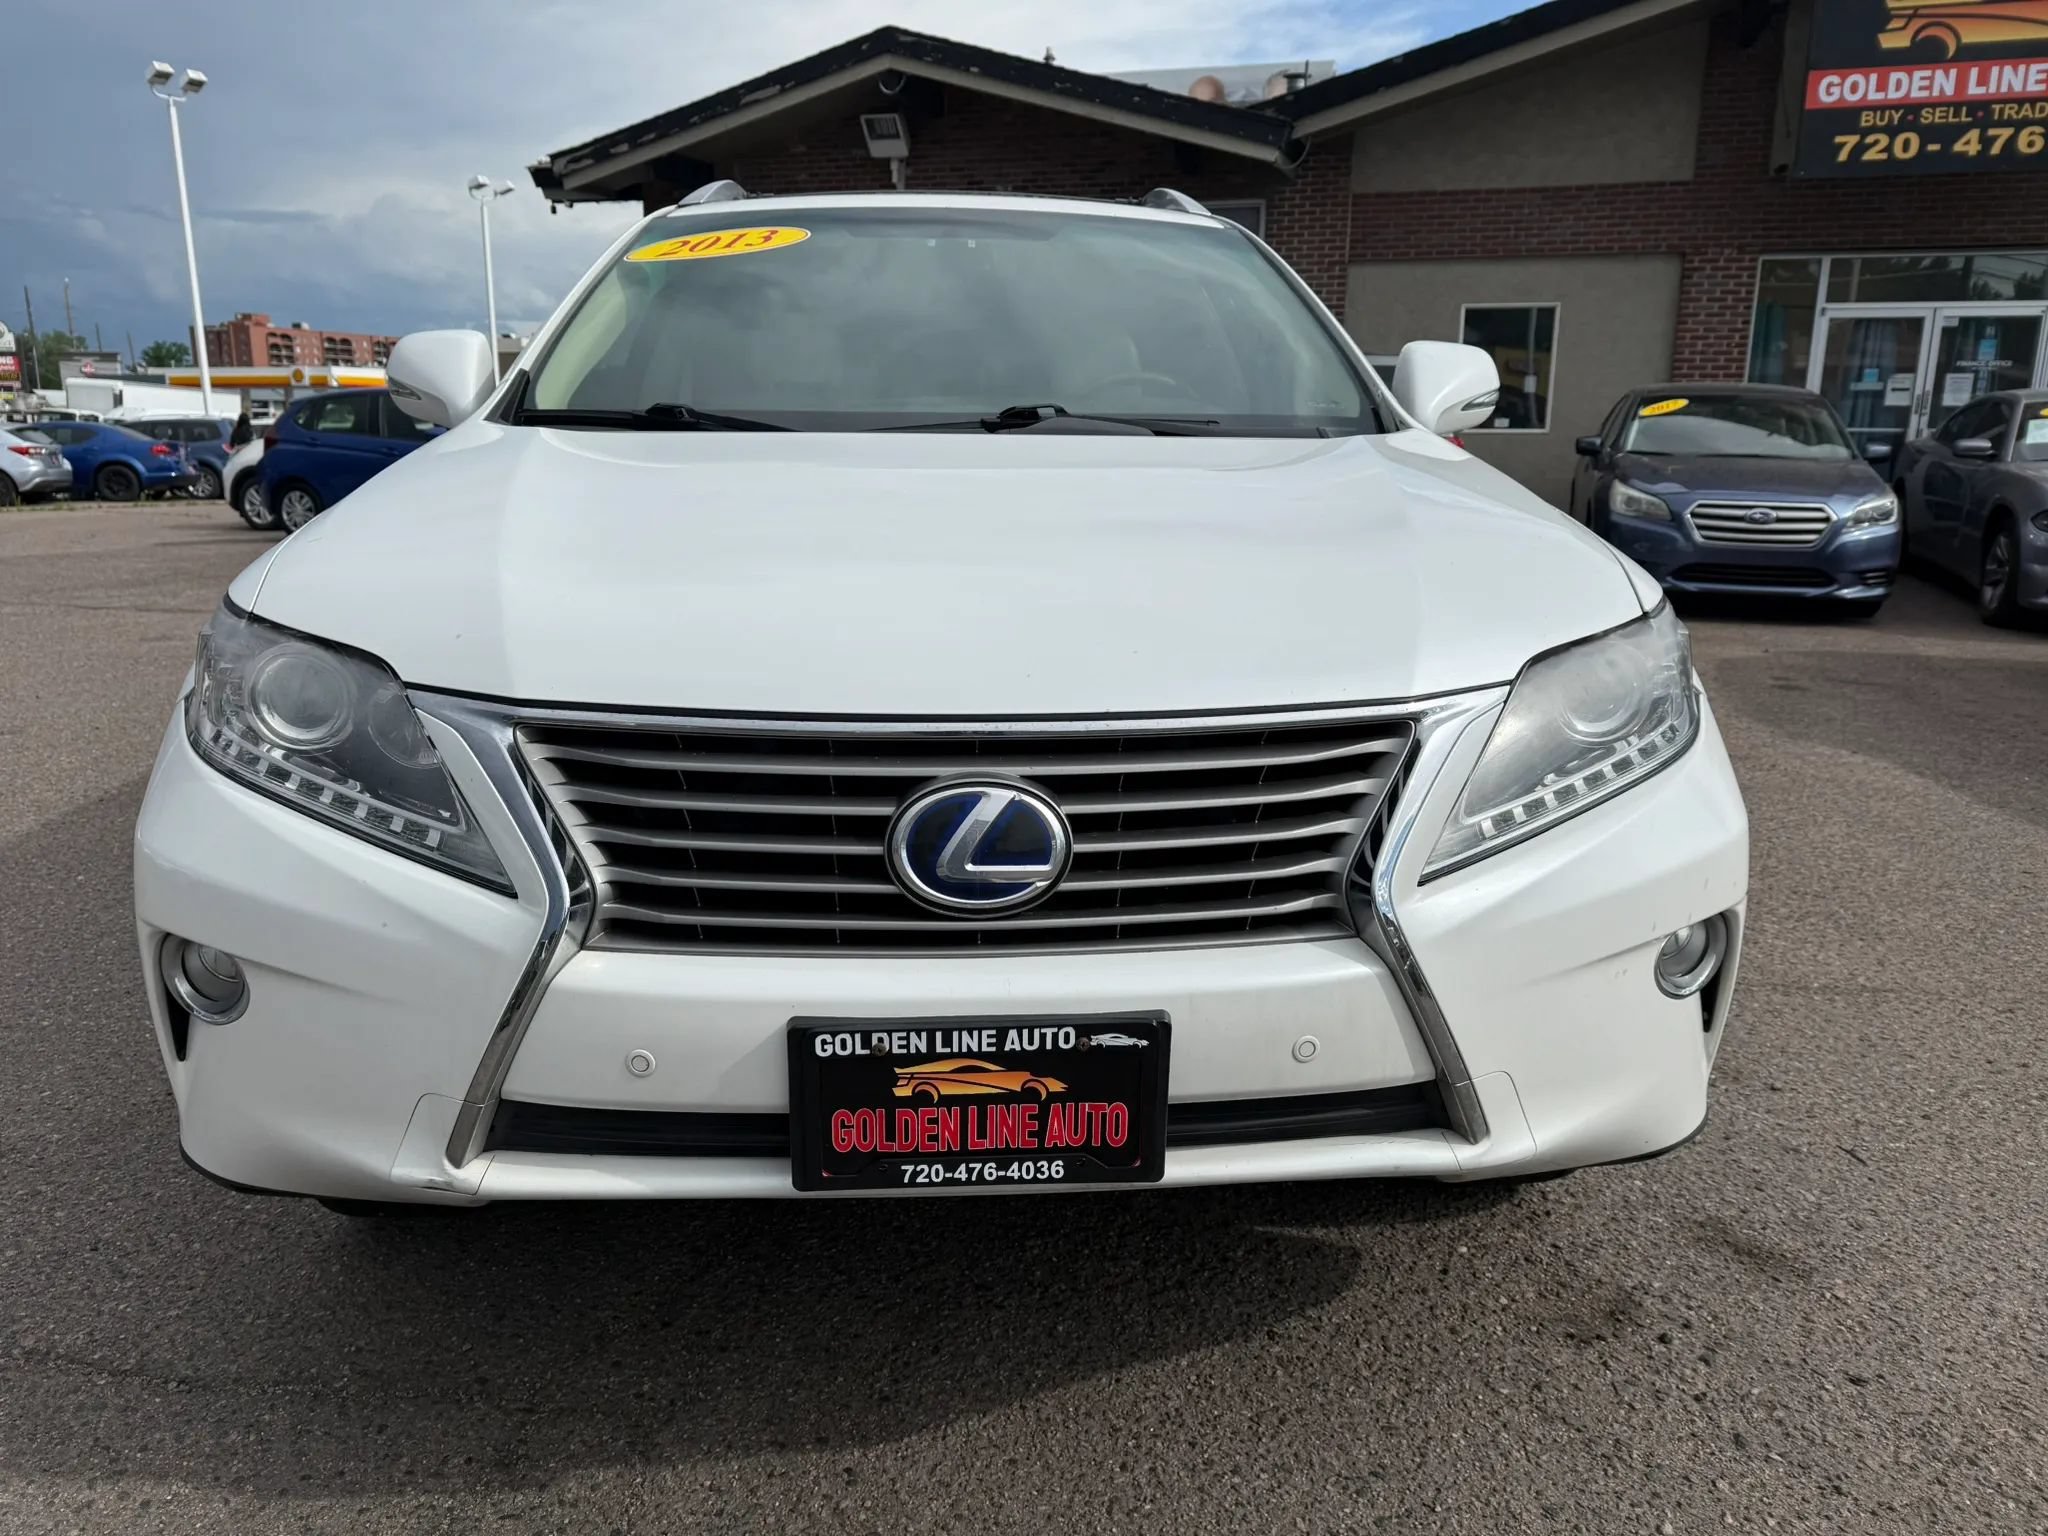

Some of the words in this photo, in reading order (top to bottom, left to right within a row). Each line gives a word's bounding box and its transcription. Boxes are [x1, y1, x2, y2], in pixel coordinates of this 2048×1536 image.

[1818, 68, 1957, 103] GOLDEN
[1967, 63, 2048, 95] LINE
[1860, 109, 1904, 126] BUY
[1919, 106, 1973, 124] SELL
[1991, 103, 2048, 121] TRAD
[655, 229, 778, 257] 2013
[814, 1031, 931, 1057] GOLDEN
[935, 1029, 997, 1053] LINE
[1004, 1026, 1077, 1051] AUTO
[831, 1107, 960, 1153] GOLDEN
[967, 1104, 1038, 1149] LINE
[1044, 1102, 1129, 1147] AUTO
[901, 1160, 1065, 1184] 720-476-4036
